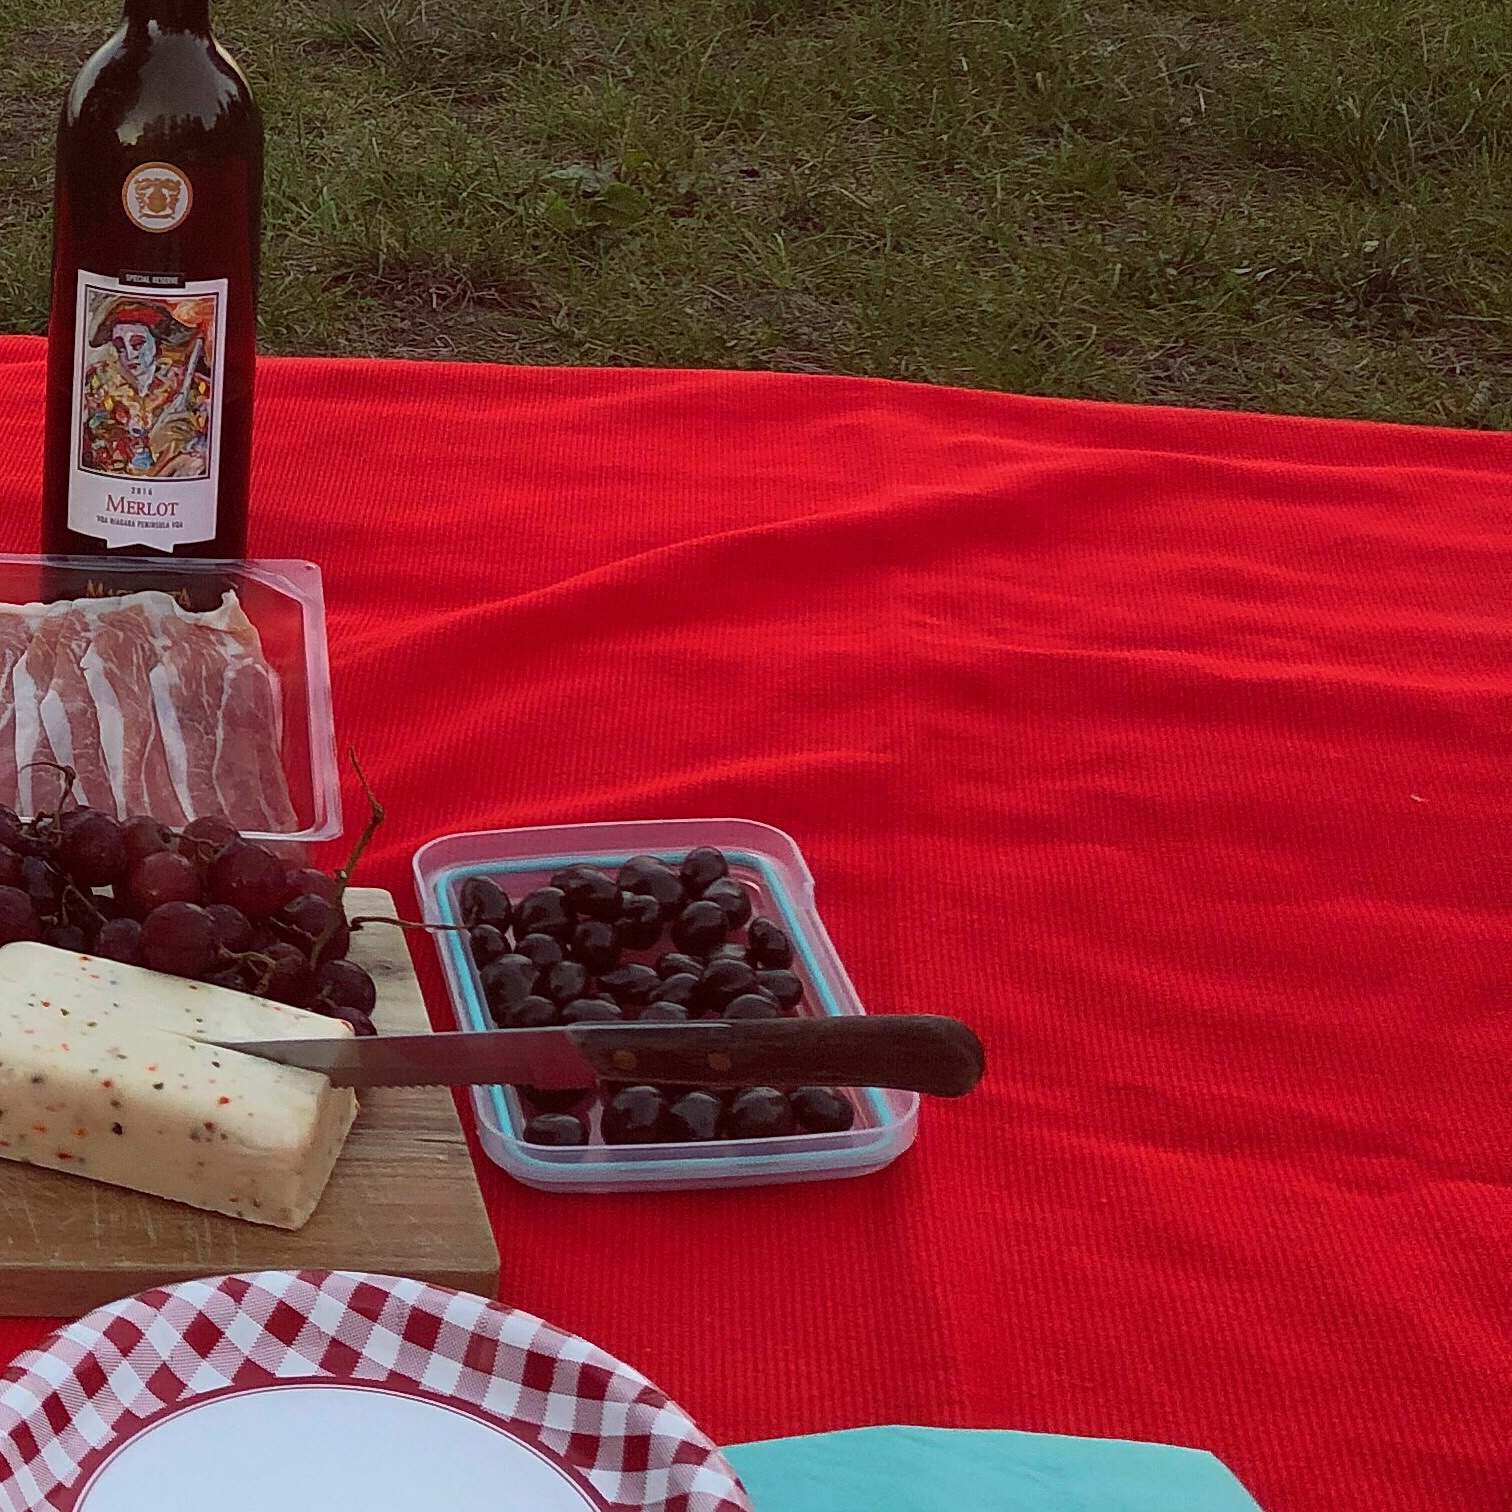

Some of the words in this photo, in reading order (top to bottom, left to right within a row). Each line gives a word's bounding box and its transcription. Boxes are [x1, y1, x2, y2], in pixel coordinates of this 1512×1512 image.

[125, 274, 150, 283] SPECIAL
[152, 276, 178, 284] RESERVE
[106, 494, 179, 516] MERLOT
[110, 517, 135, 528] NIAGARA
[137, 520, 170, 528] PENINSULA
